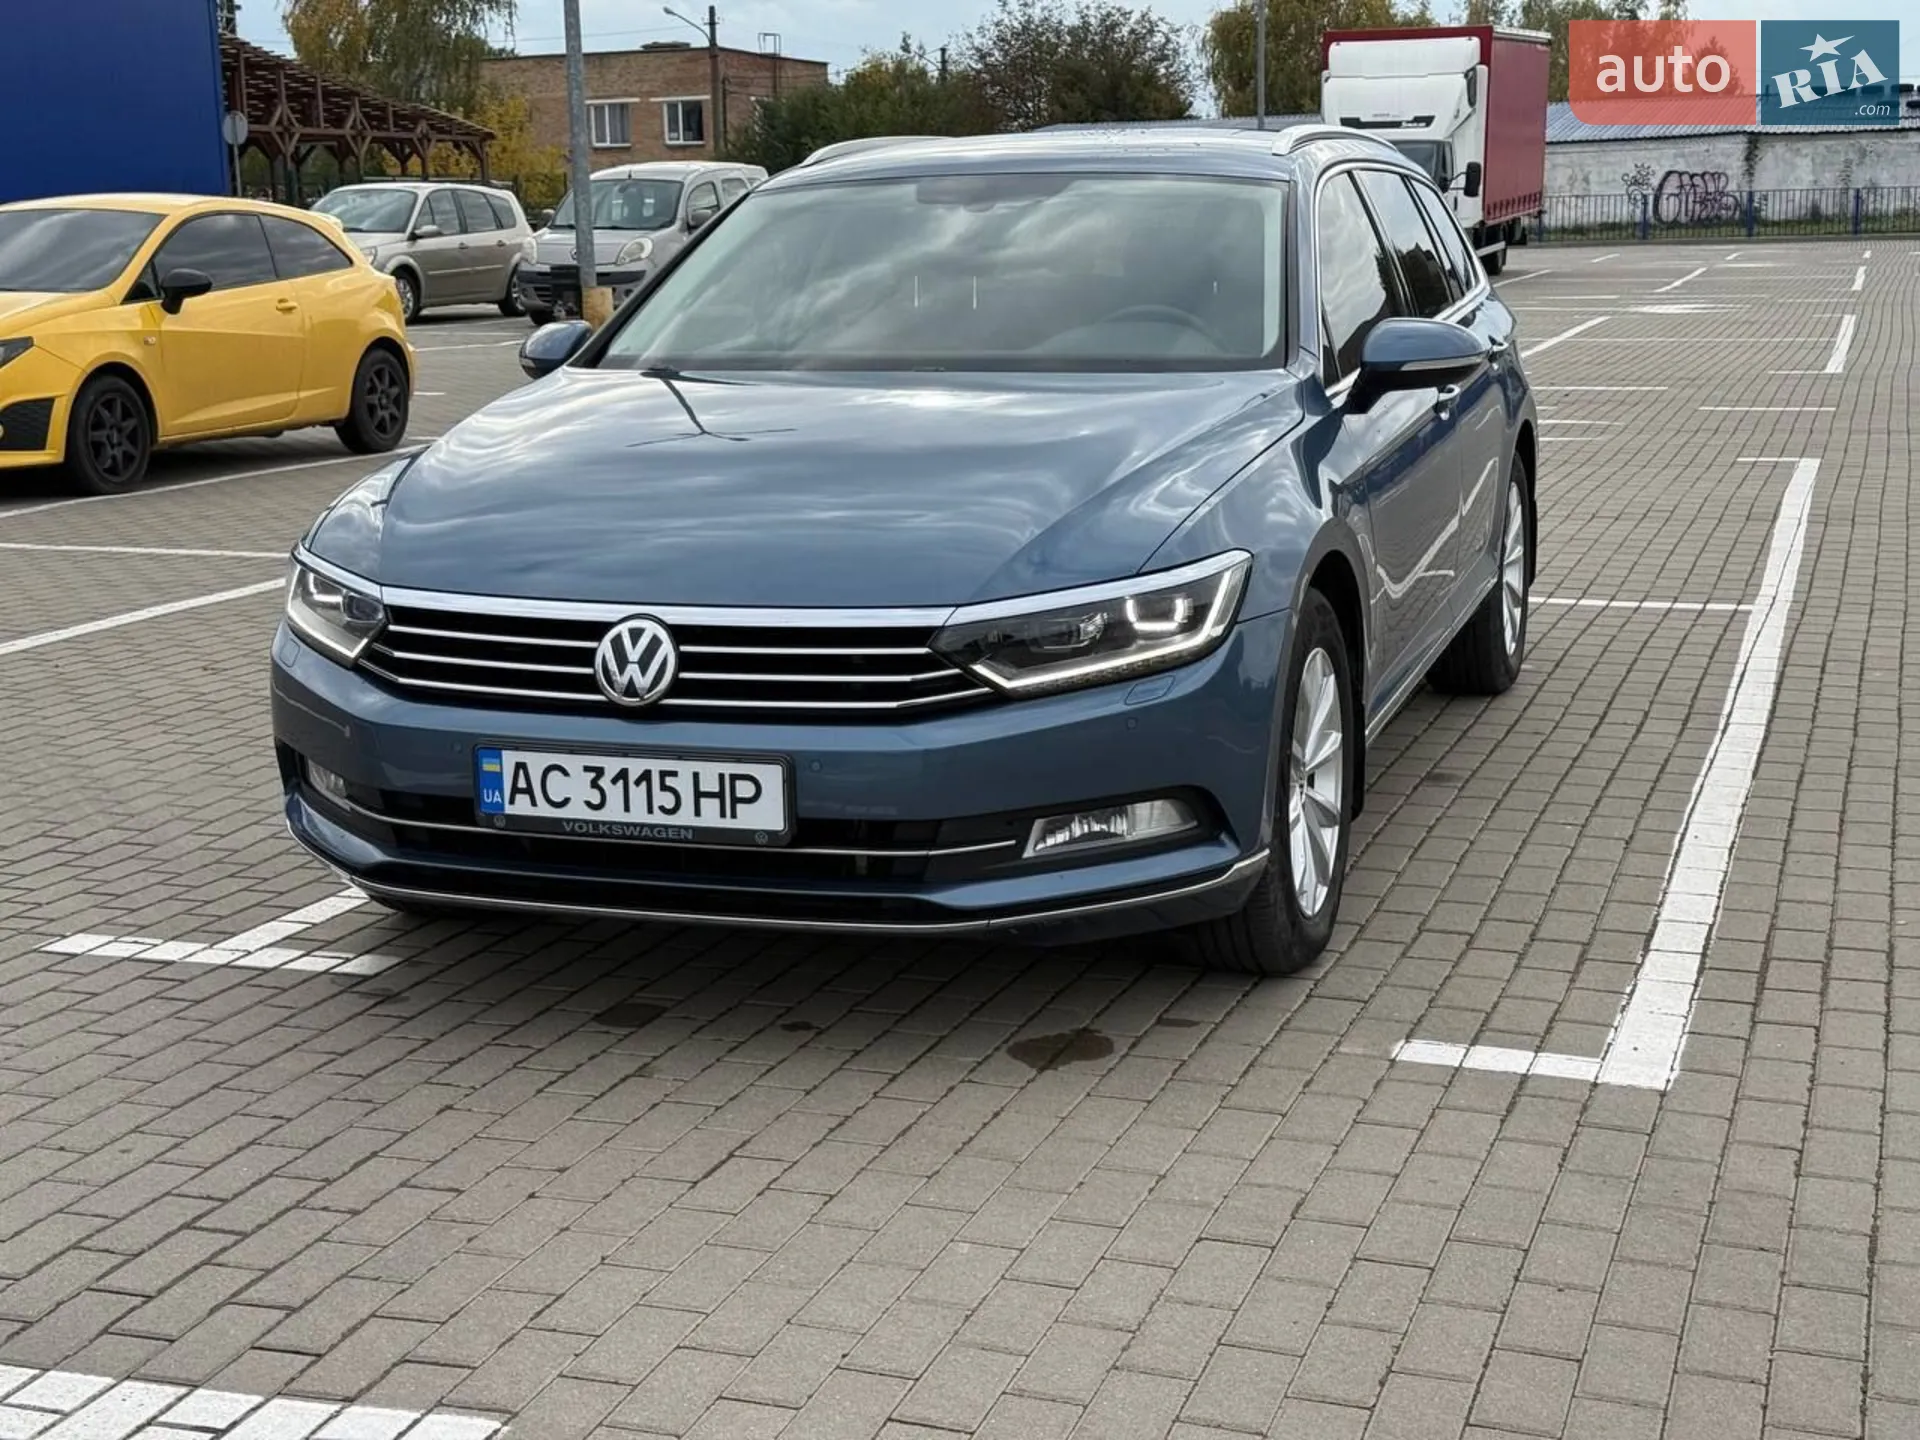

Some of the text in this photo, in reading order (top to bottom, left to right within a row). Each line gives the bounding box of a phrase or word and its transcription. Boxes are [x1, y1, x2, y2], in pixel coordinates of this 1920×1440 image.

[483, 788, 502, 803] UA
[508, 761, 763, 819] AC 3115 HP
[562, 821, 693, 840] VOLKSWAGEN
